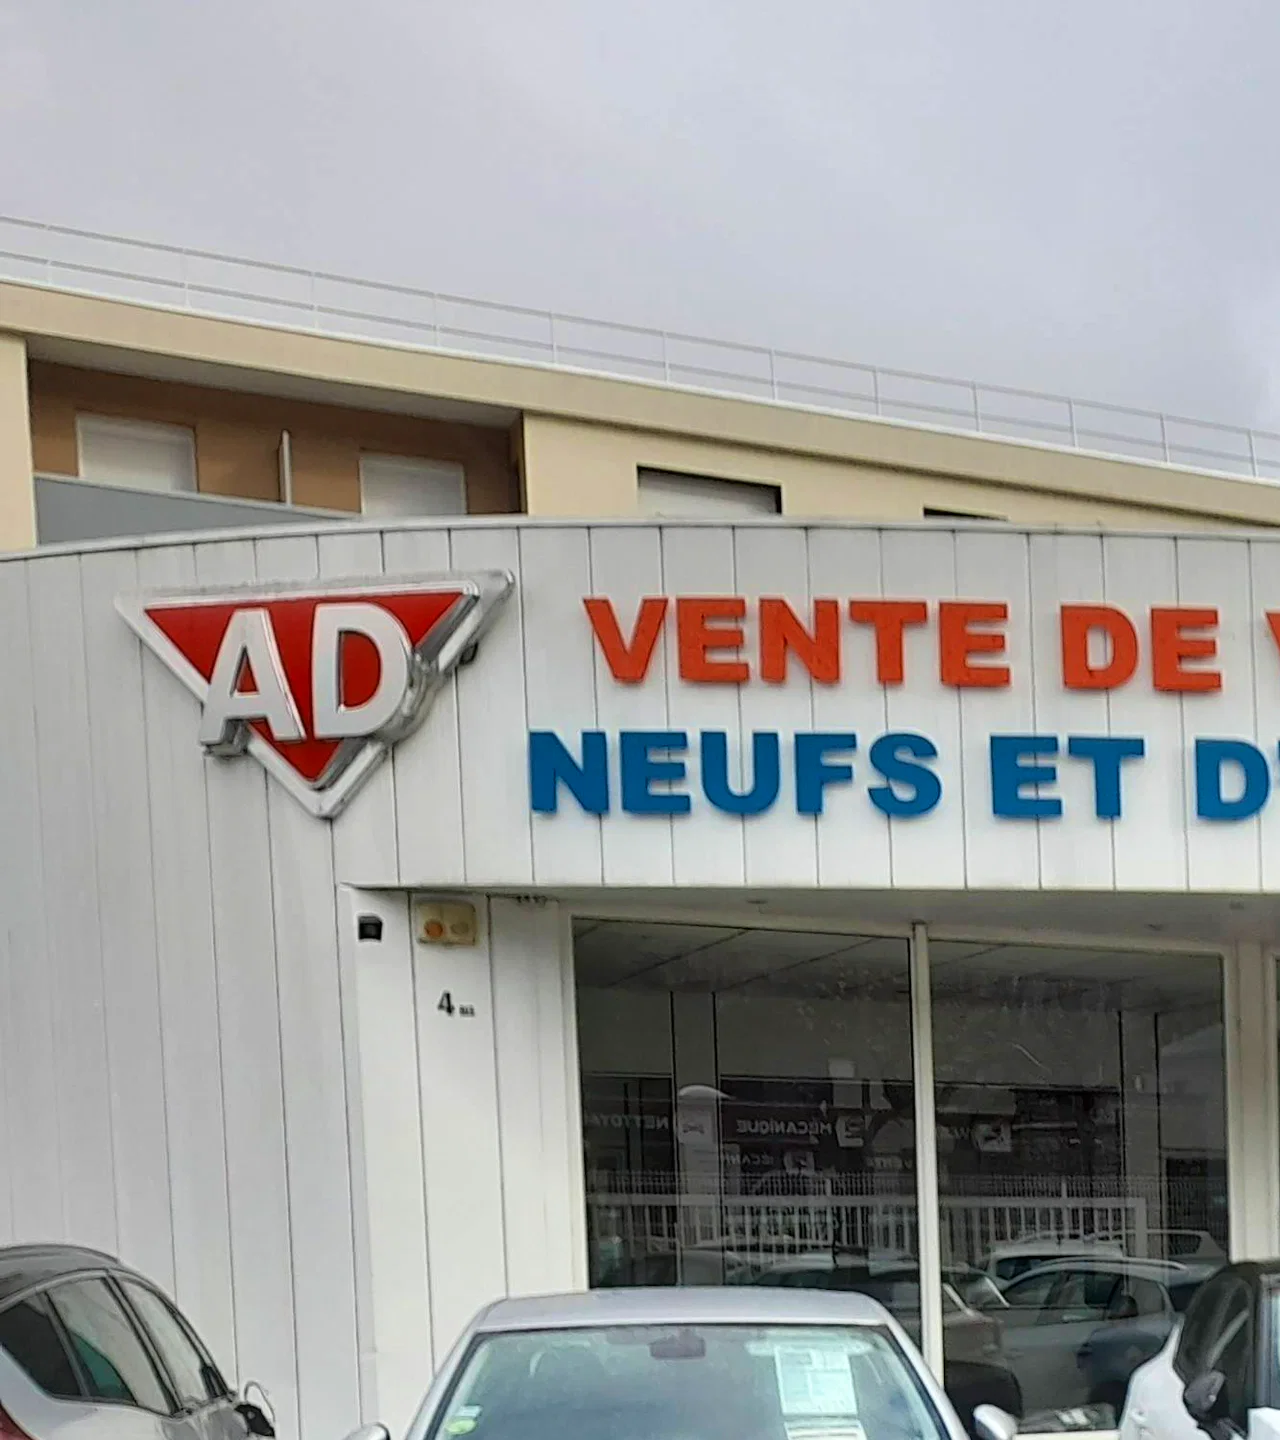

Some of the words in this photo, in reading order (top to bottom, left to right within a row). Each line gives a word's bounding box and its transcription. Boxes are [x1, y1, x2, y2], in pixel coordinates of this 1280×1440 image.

[201, 603, 413, 745] AD
[585, 597, 1012, 687] VENTE
[1060, 605, 1223, 692] DE
[527, 729, 944, 820] NEUFS
[988, 734, 1148, 821] ET
[437, 990, 455, 1016] 4
